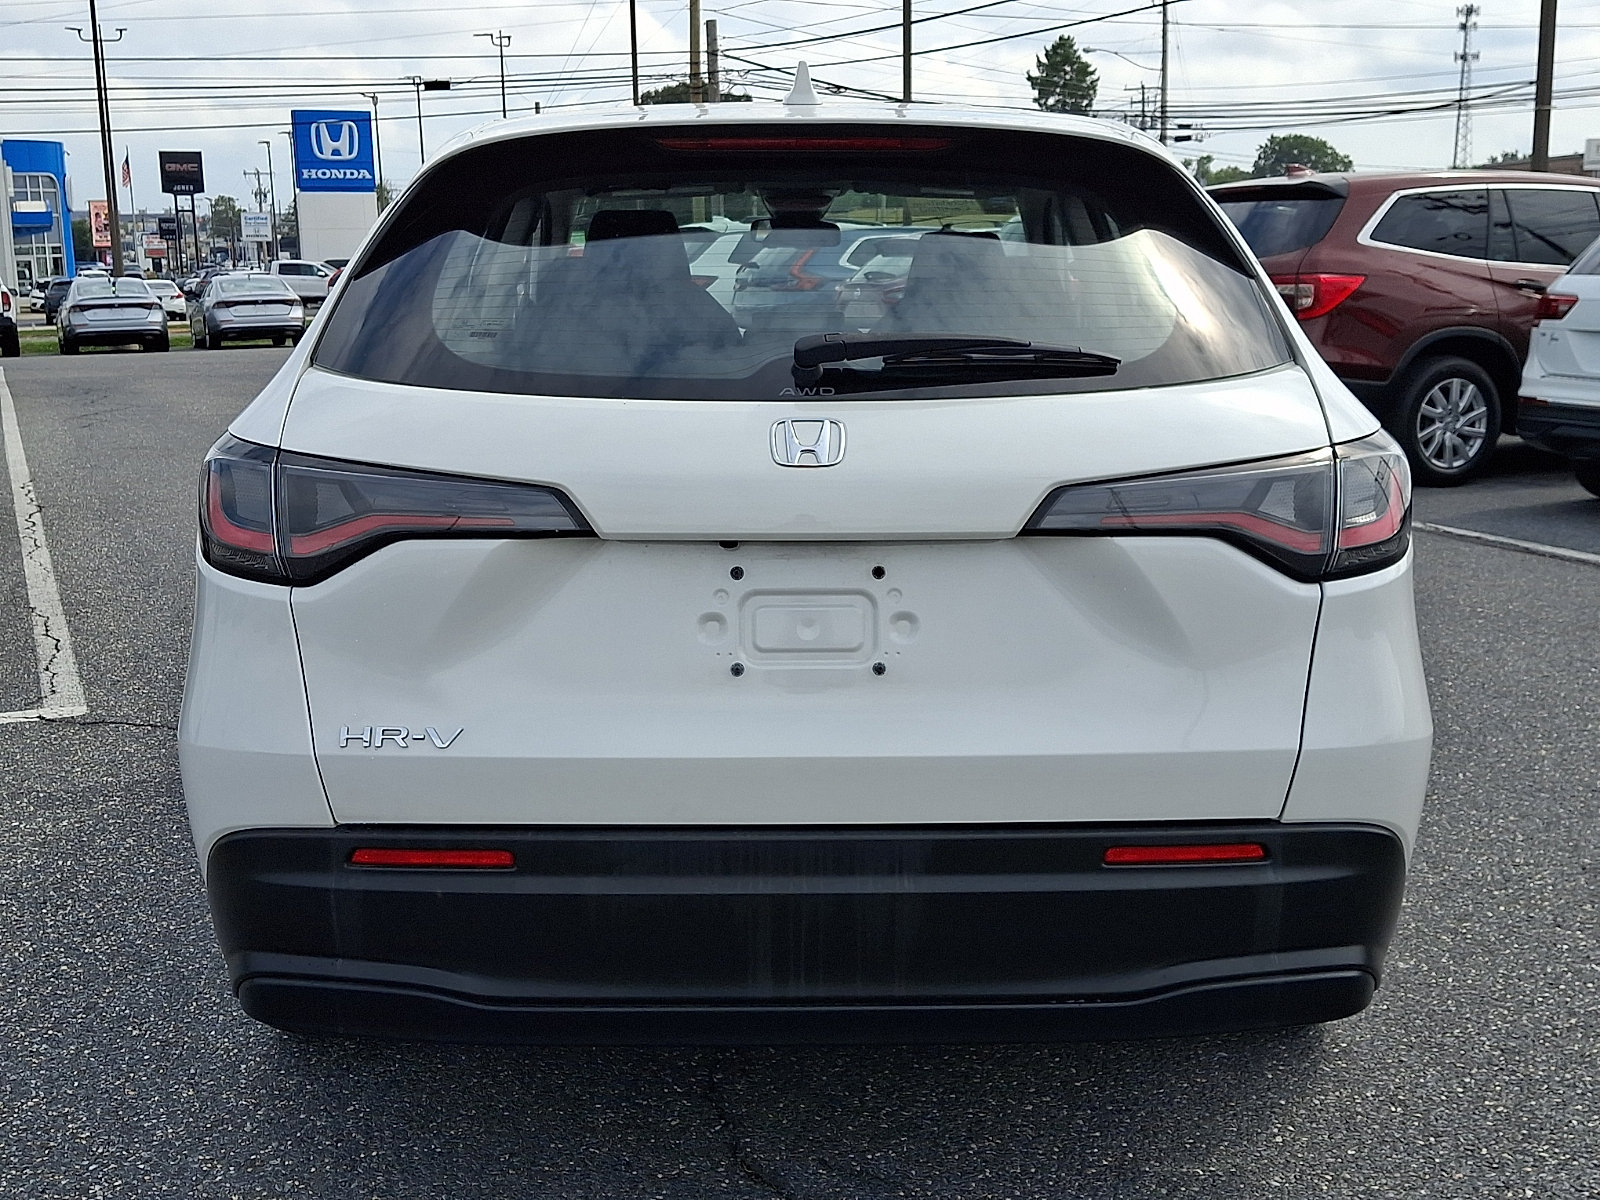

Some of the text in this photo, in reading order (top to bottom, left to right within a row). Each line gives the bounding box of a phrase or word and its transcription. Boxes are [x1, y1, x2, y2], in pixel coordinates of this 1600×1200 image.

[165, 163, 198, 171] GMC
[301, 168, 372, 179] HONDA
[779, 387, 835, 396] AWD
[339, 726, 464, 749] HR-V
